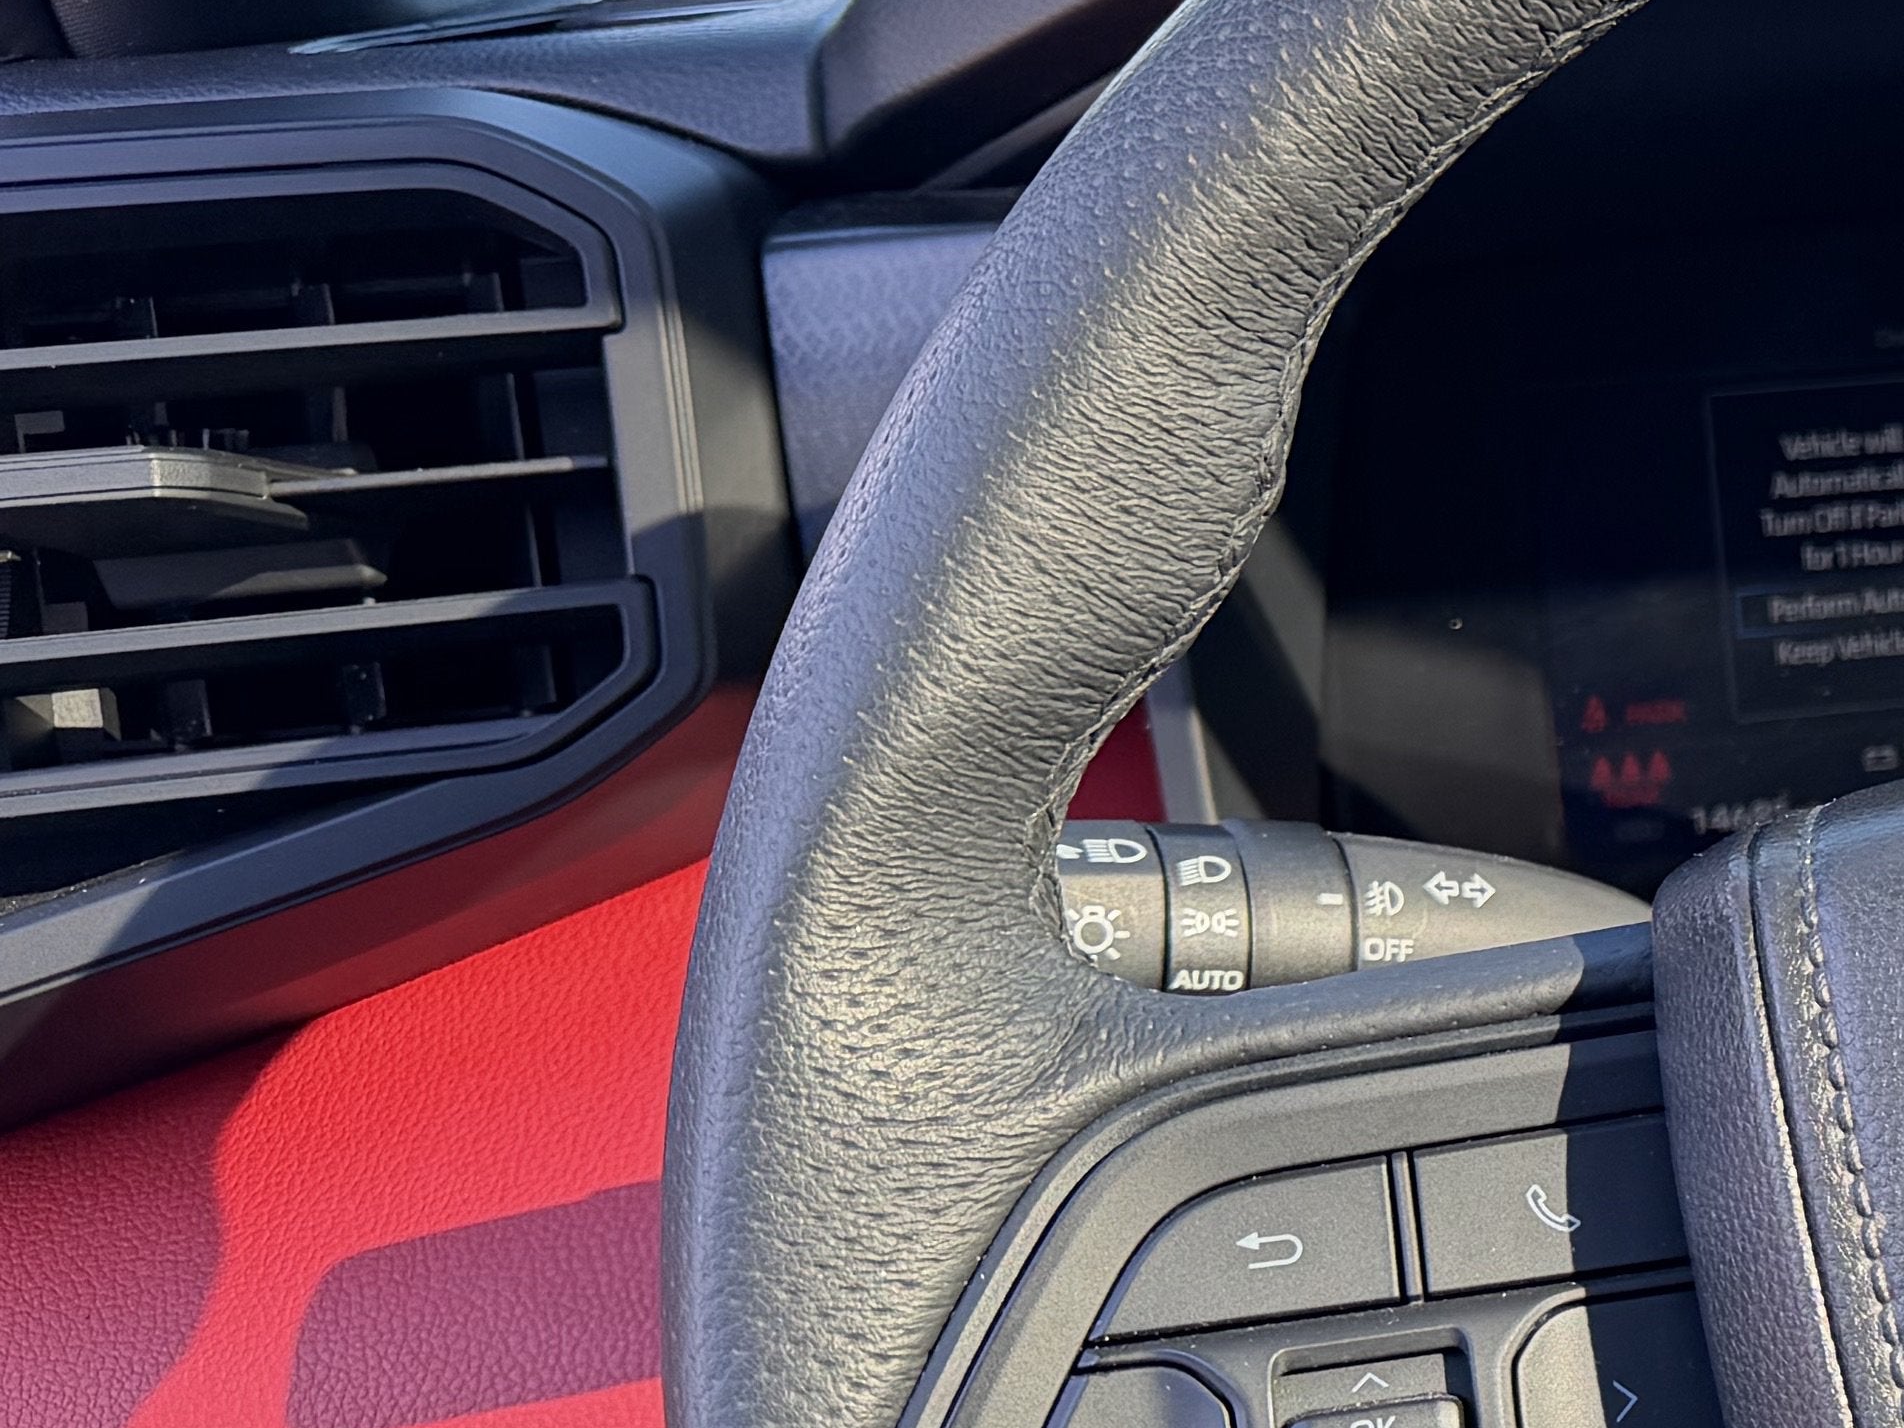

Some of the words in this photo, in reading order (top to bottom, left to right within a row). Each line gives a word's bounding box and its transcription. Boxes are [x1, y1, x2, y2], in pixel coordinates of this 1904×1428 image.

[1779, 428, 1864, 461] Vehicle
[1767, 592, 1860, 623] Perform
[1775, 637, 1836, 666] Keep
[1364, 937, 1414, 964] OFF
[1172, 967, 1245, 993] AUTO
